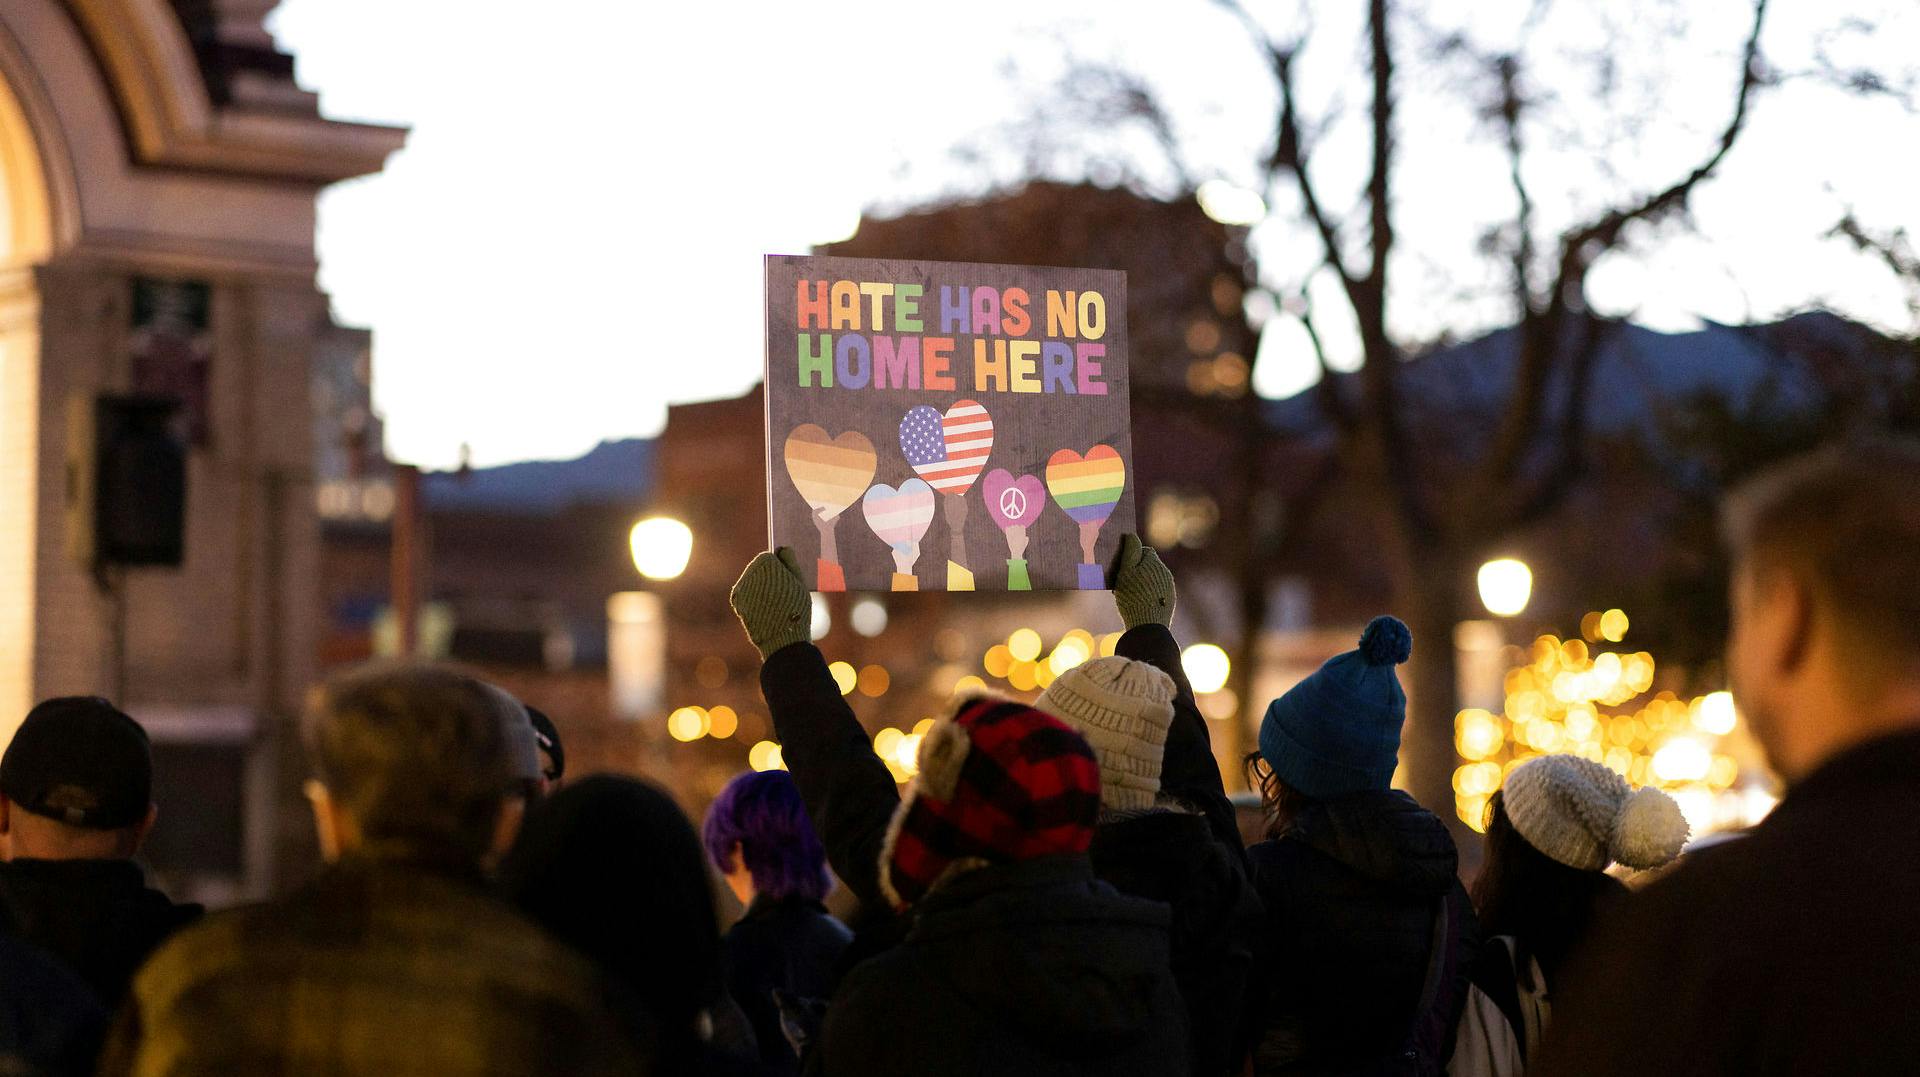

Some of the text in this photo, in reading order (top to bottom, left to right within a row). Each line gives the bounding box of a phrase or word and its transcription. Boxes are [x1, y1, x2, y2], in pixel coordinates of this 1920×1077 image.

[797, 280, 1106, 340] HATE HAS NO
[797, 333, 1108, 395] HOME HERE
